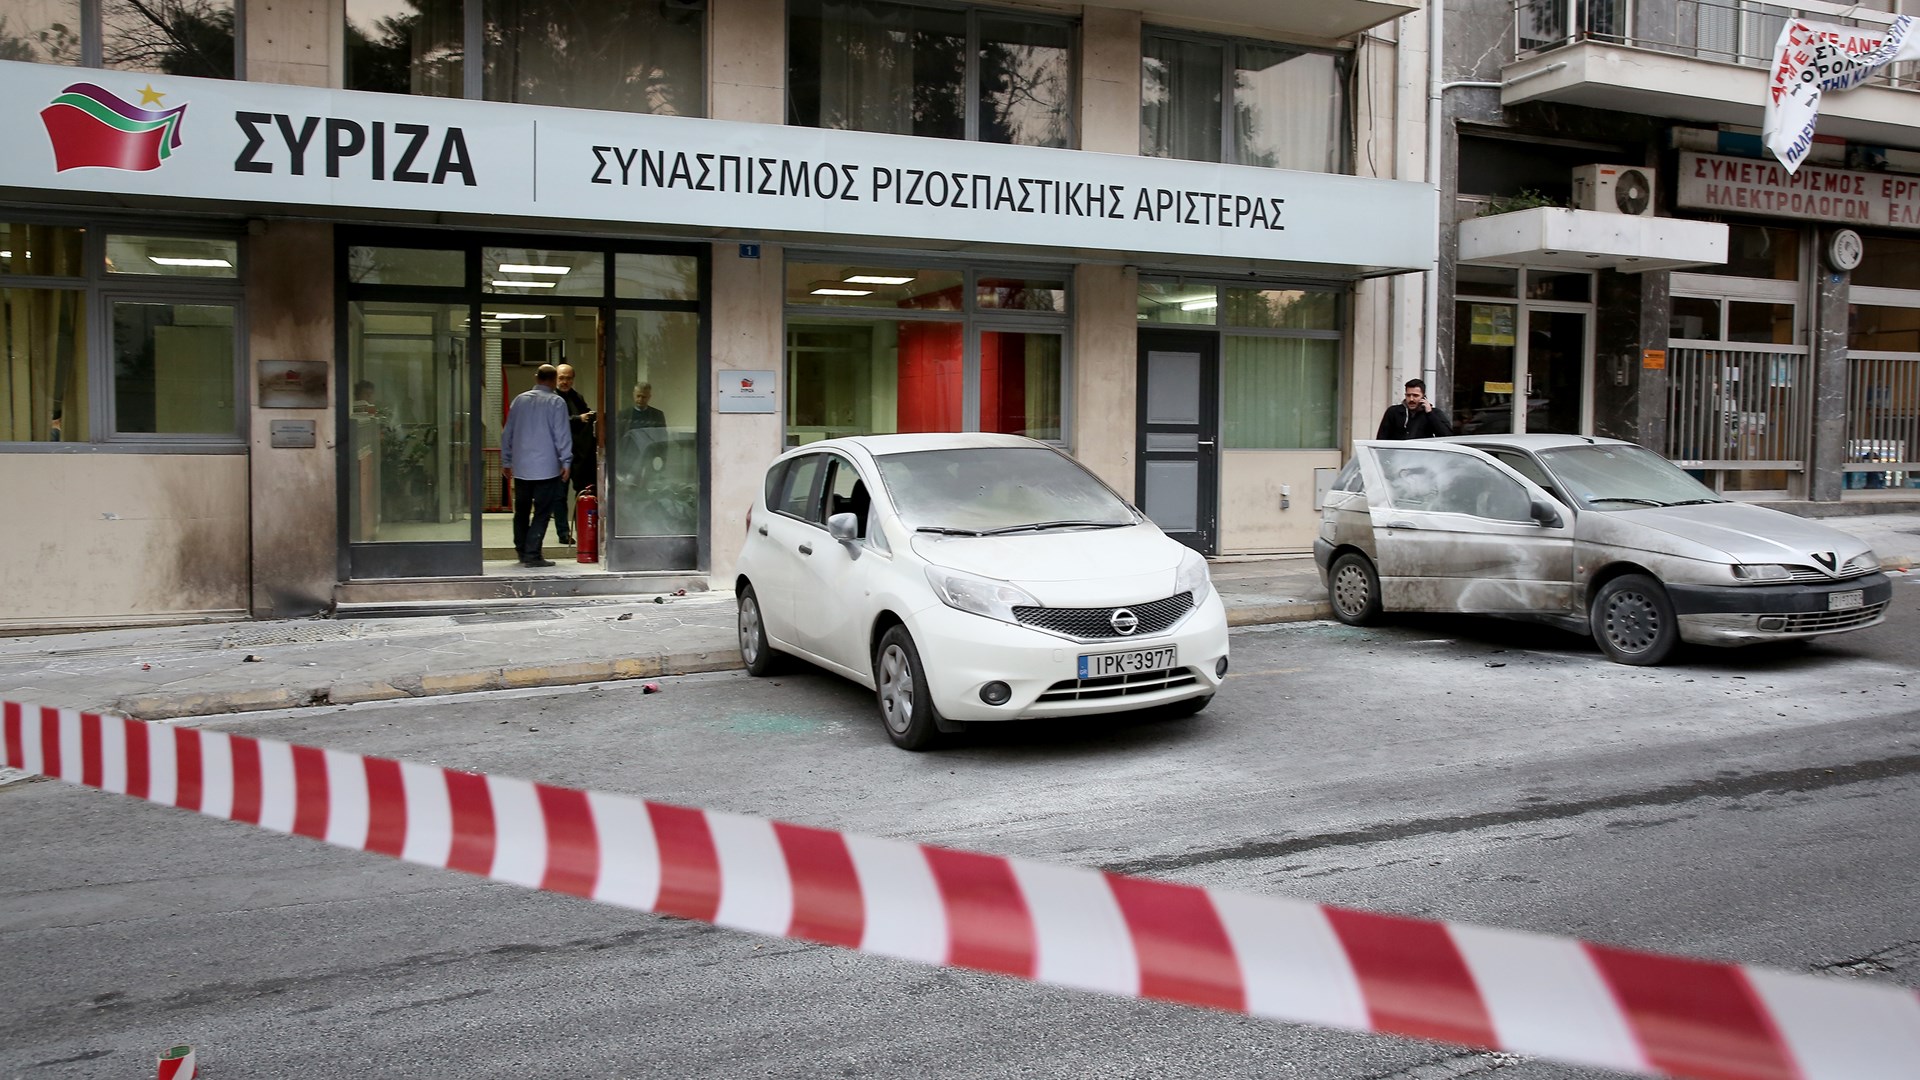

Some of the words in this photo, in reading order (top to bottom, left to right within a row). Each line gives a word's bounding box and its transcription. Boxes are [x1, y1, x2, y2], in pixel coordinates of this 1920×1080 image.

[234, 110, 478, 187] ΣΥΡΙΖΑ
[591, 145, 859, 201] ΣΥΝΑΣΠΙΣΜΟΣ
[872, 166, 1125, 222] ΡΙΖΟΣΠΑΣΤΙΚΗΣ
[1133, 187, 1285, 231] ΑΡΙΣΤΕΡΑΣ
[1695, 157, 1865, 196] ΣΥΝΕΤΑΙΡΙΣΜΟΣ
[1881, 178, 1920, 201] ΕΡΓ
[1706, 184, 1869, 220] ΗΛΕΚΤΡΟΛΟΓΩΝ
